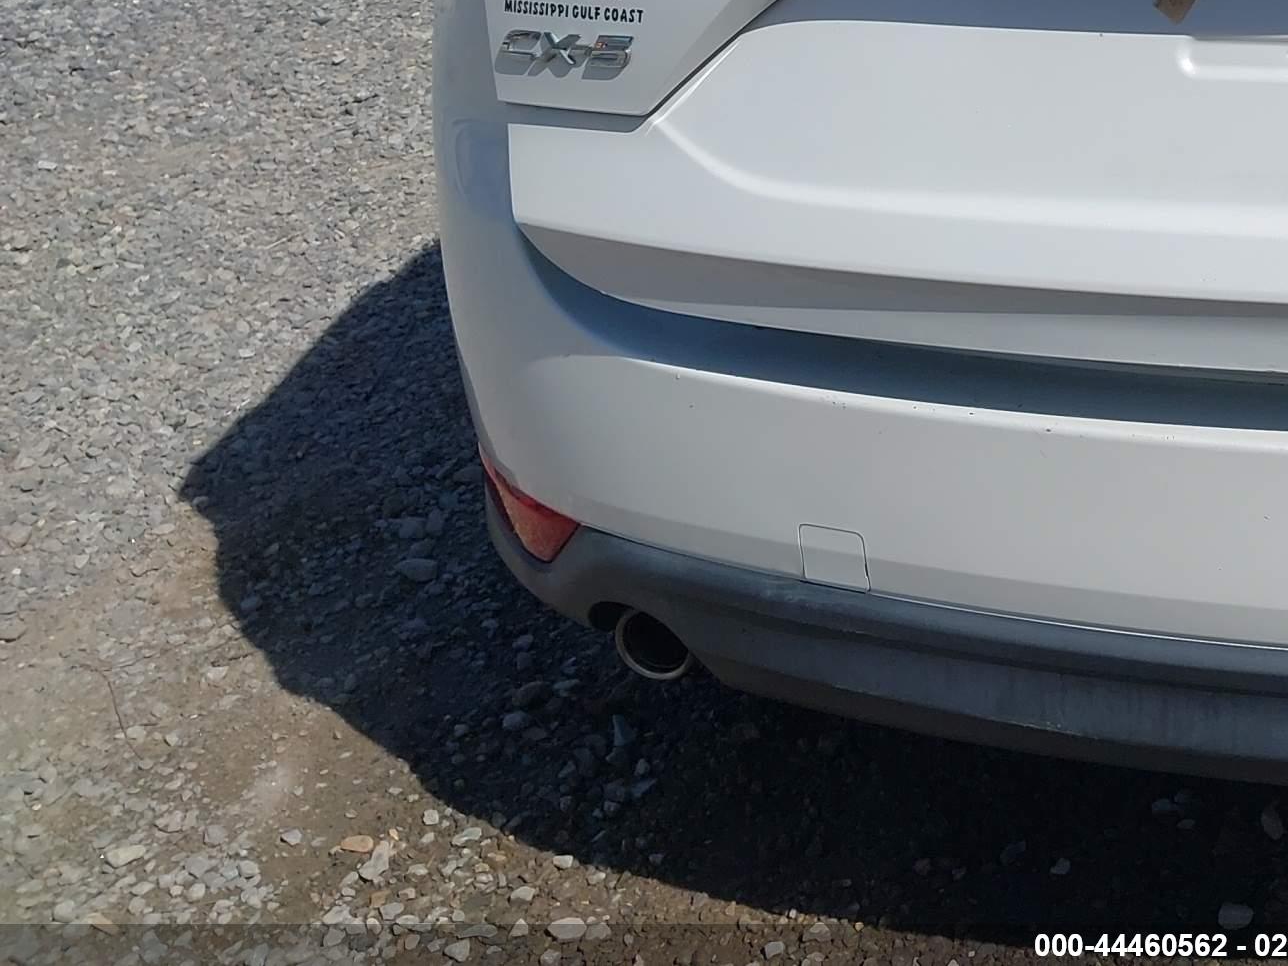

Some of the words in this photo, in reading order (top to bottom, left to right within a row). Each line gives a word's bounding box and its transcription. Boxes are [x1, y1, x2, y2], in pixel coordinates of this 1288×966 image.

[504, 0, 569, 17] MISSISSIPPI
[572, 5, 601, 20] GULF
[604, 8, 644, 23] COAST
[501, 30, 634, 68] CX-5
